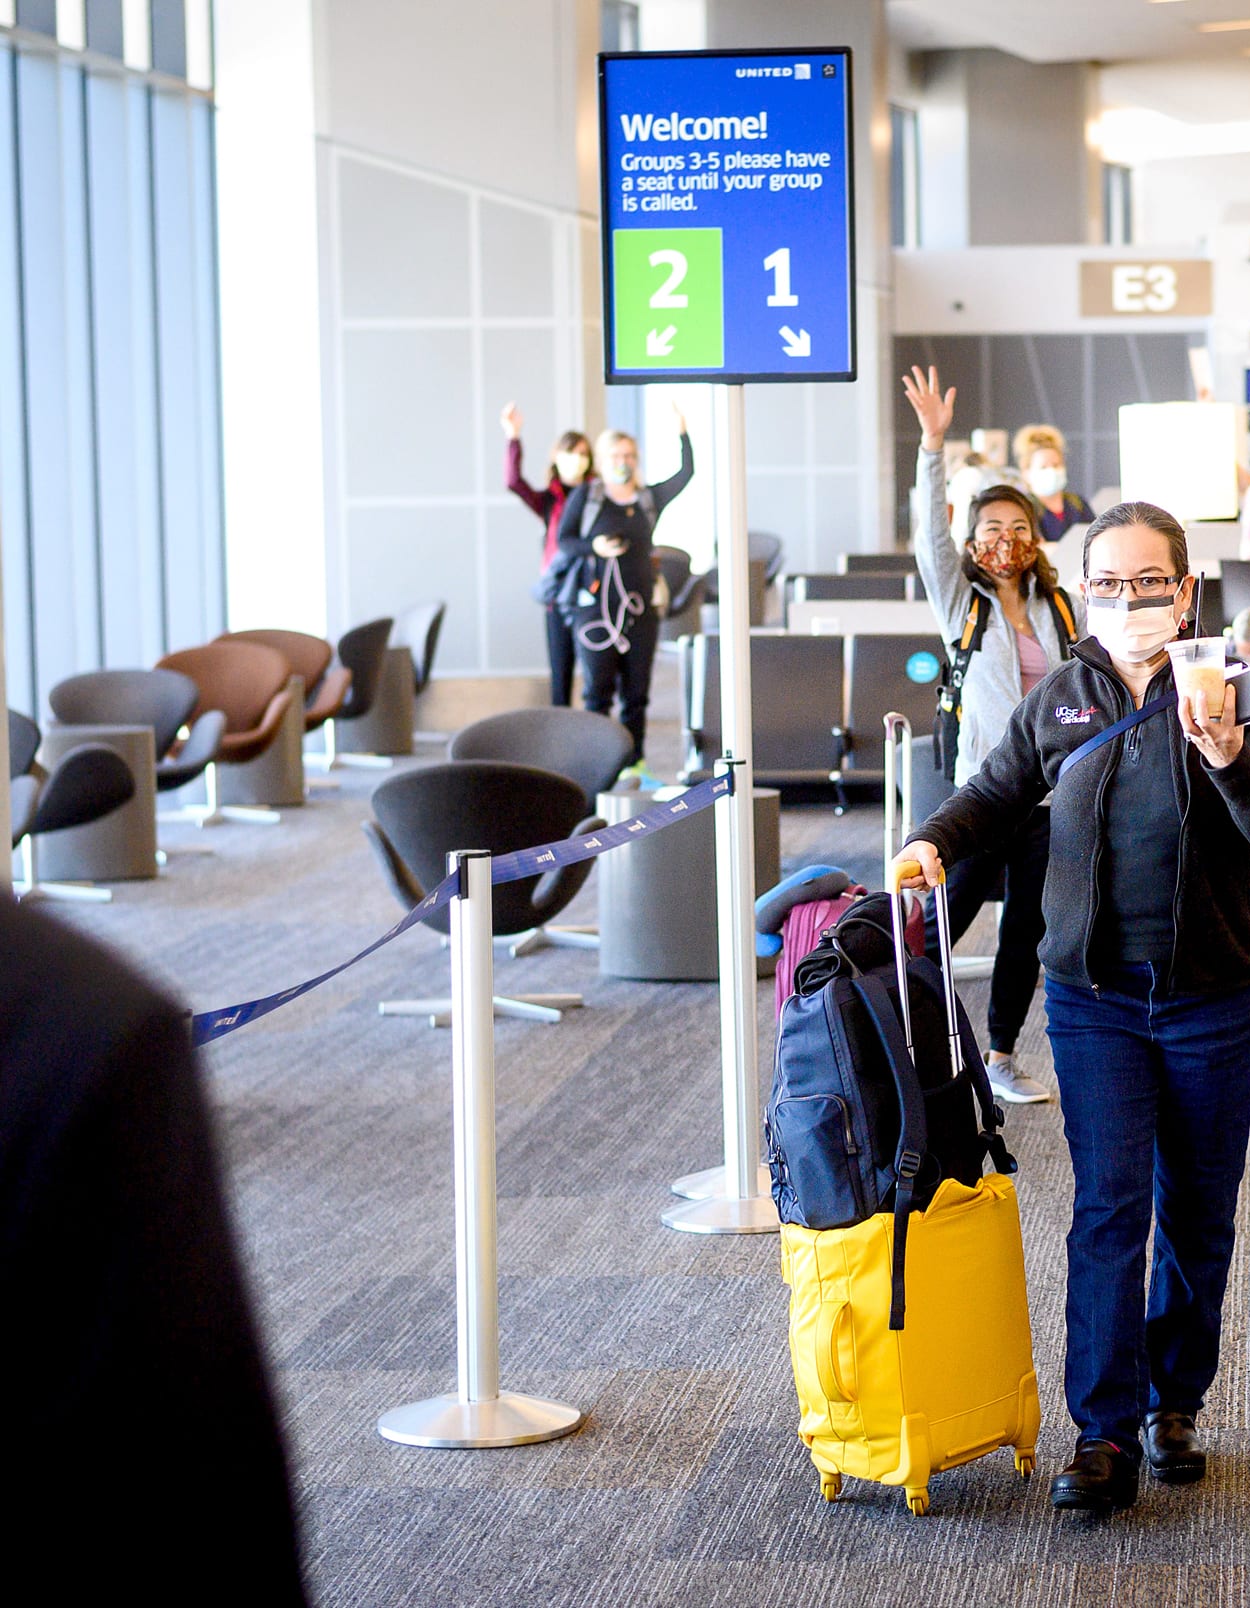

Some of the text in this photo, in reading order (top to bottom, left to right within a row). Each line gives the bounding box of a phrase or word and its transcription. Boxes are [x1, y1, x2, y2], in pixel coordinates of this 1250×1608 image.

[735, 67, 793, 78] UNITED
[620, 112, 768, 142] Welcome!
[621, 150, 831, 173] Groups 3-5 please have
[621, 172, 823, 192] a seat until your group
[622, 193, 698, 212] is called.
[648, 249, 688, 308] 2
[763, 247, 799, 307] 1
[1112, 267, 1177, 312] E3
[1055, 706, 1078, 718] UCSF
